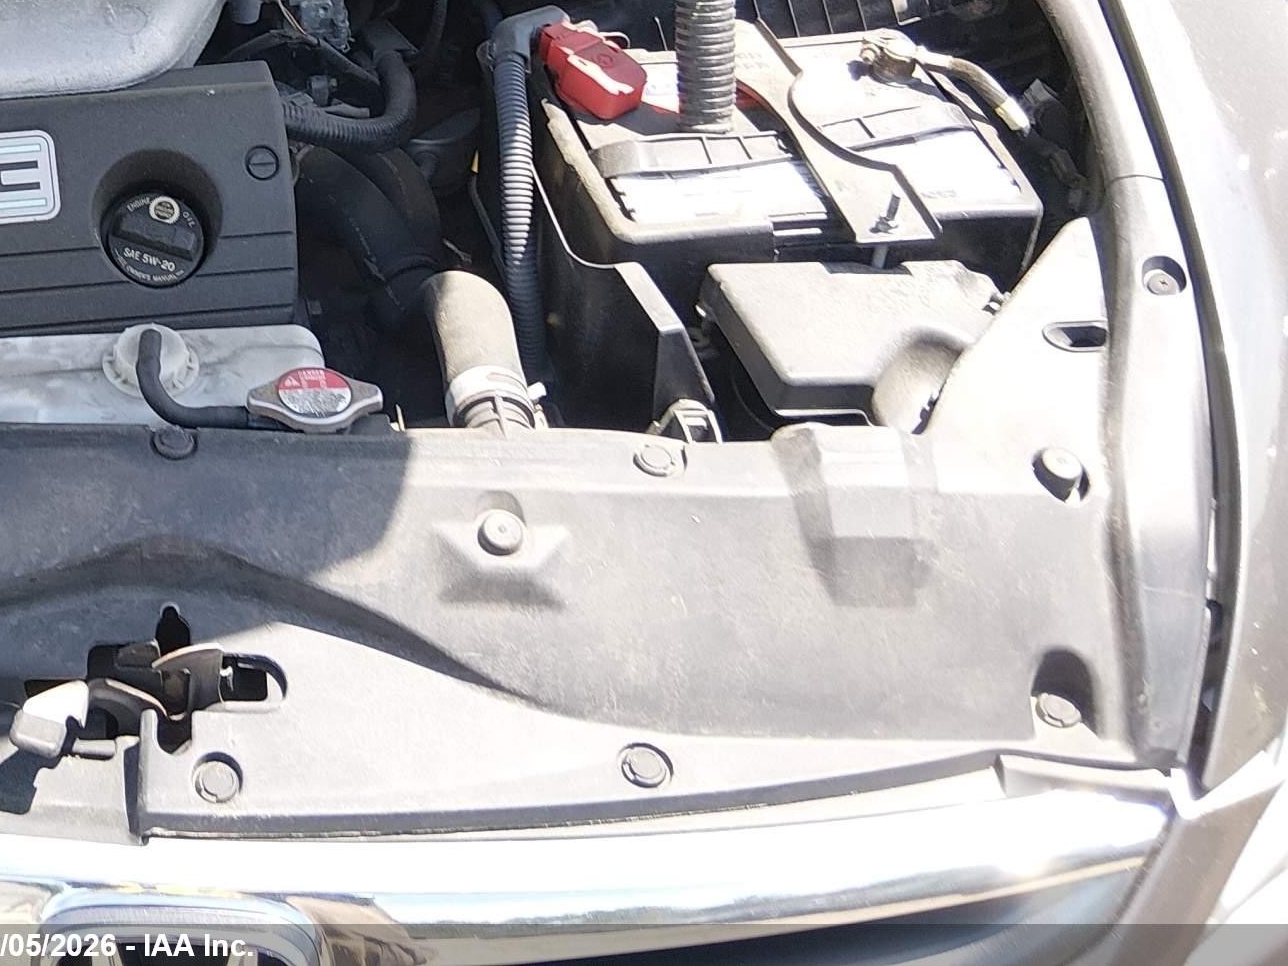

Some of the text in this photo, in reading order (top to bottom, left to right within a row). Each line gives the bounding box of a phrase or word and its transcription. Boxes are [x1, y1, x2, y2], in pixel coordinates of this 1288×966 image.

[182, 211, 196, 228] OIL
[123, 247, 141, 262] SAE
[141, 252, 176, 272] 5W-20
